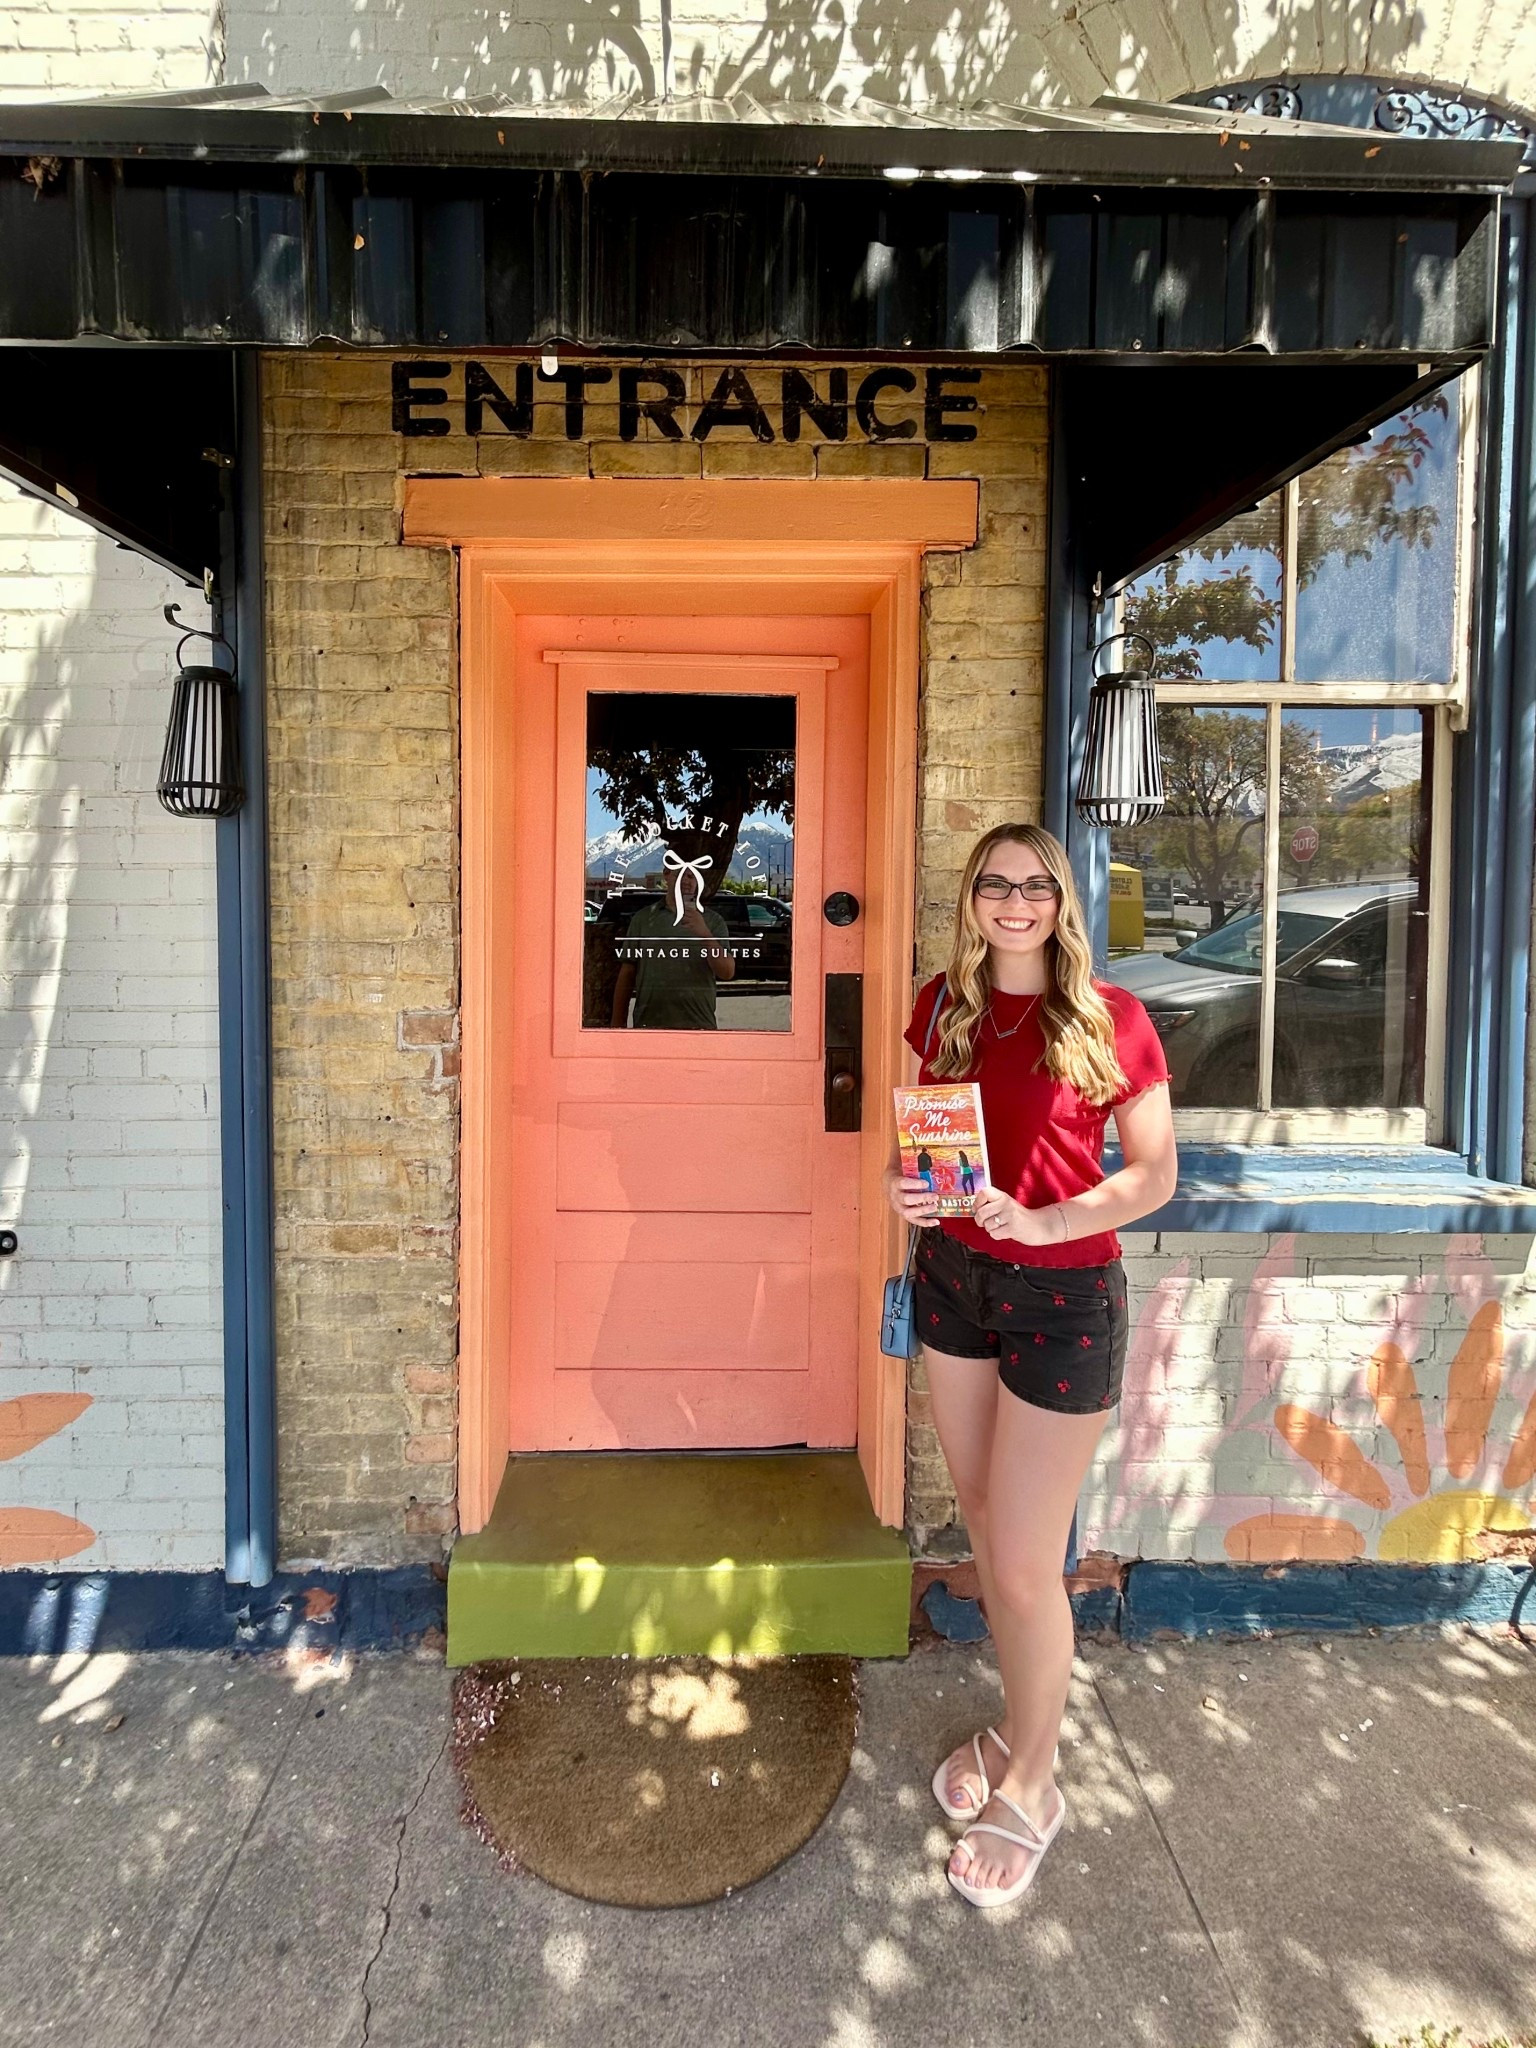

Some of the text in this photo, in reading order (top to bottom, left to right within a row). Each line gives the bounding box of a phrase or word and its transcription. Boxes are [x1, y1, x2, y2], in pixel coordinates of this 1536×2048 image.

[391, 361, 982, 442] ENTRANCE
[607, 854, 631, 899] THE
[735, 841, 771, 899] LOFT
[614, 948, 761, 958] VINTAGE SUITES
[903, 1093, 968, 1118] Promise
[924, 1111, 952, 1128] Me
[909, 1123, 973, 1142] Sunshine
